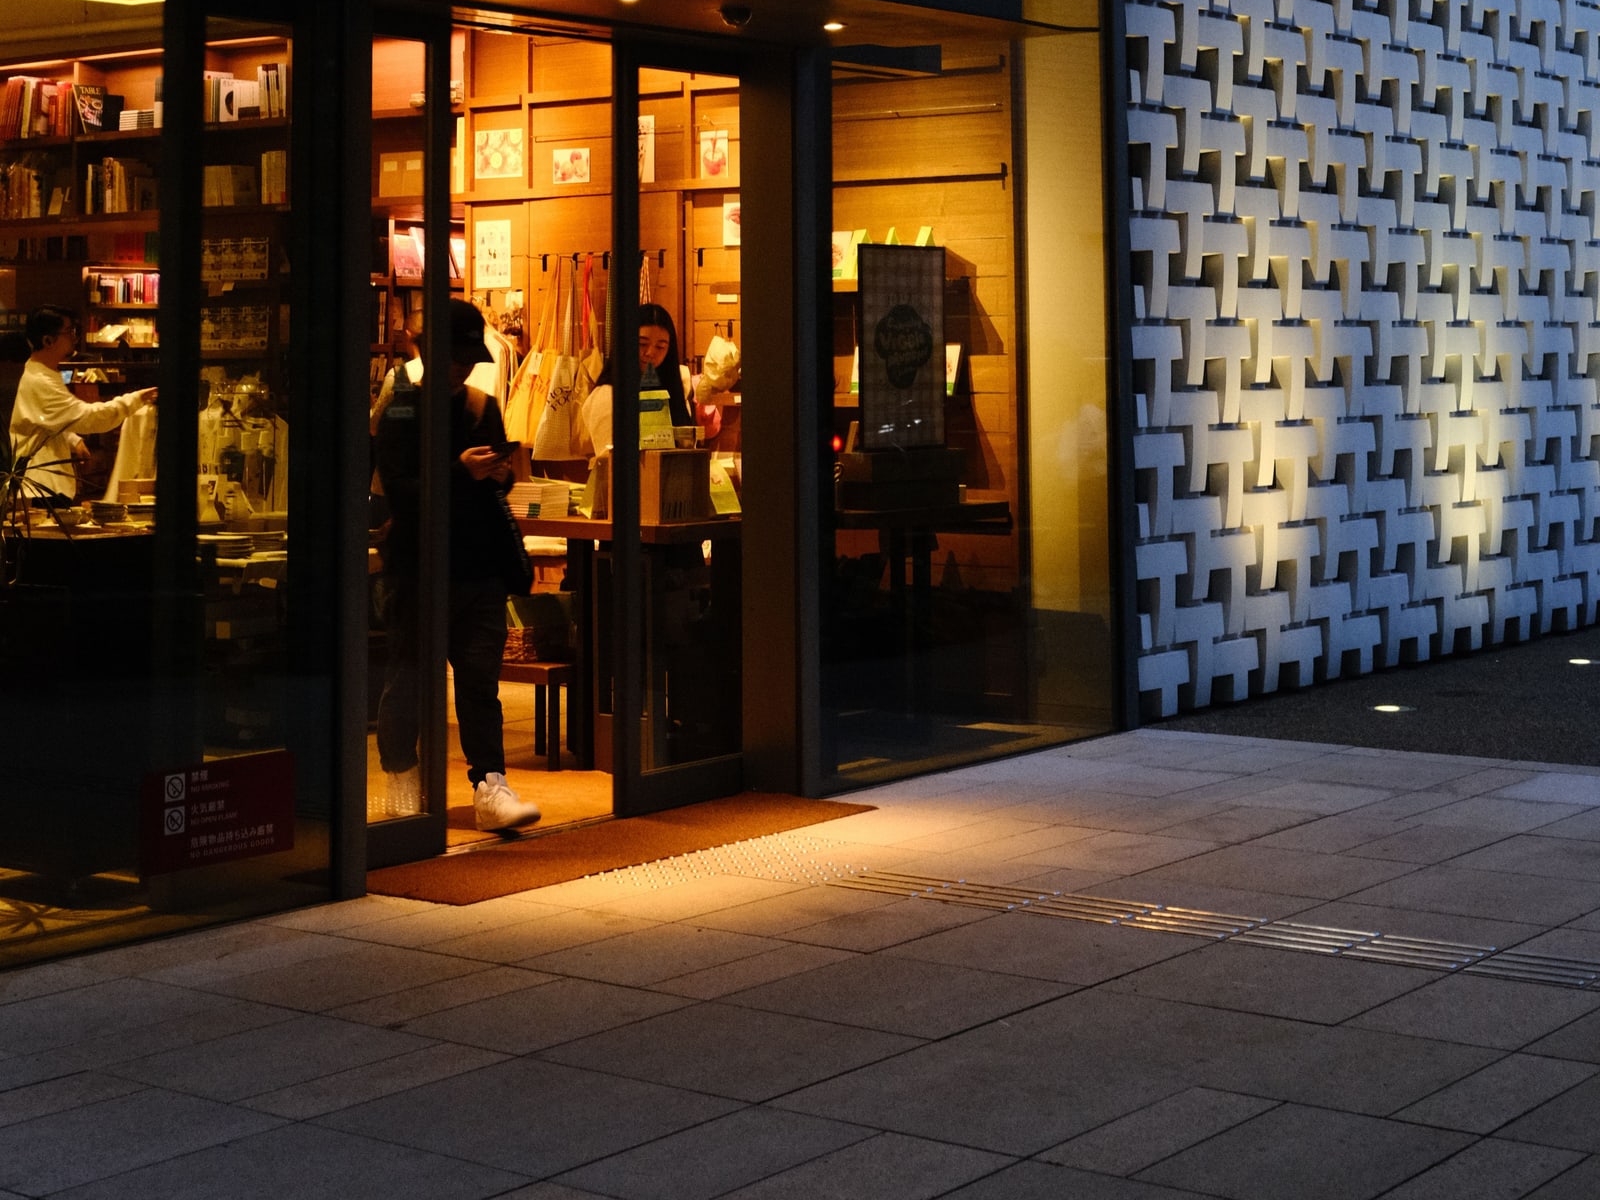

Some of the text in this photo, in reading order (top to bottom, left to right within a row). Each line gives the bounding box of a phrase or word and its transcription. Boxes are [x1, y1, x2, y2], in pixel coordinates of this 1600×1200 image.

[79, 86, 101, 95] TABLE
[190, 784, 200, 793] NO
[190, 817, 200, 825] NO
[201, 814, 217, 824] OPEN
[190, 837, 275, 859] NO DANGEROUS GOODS
